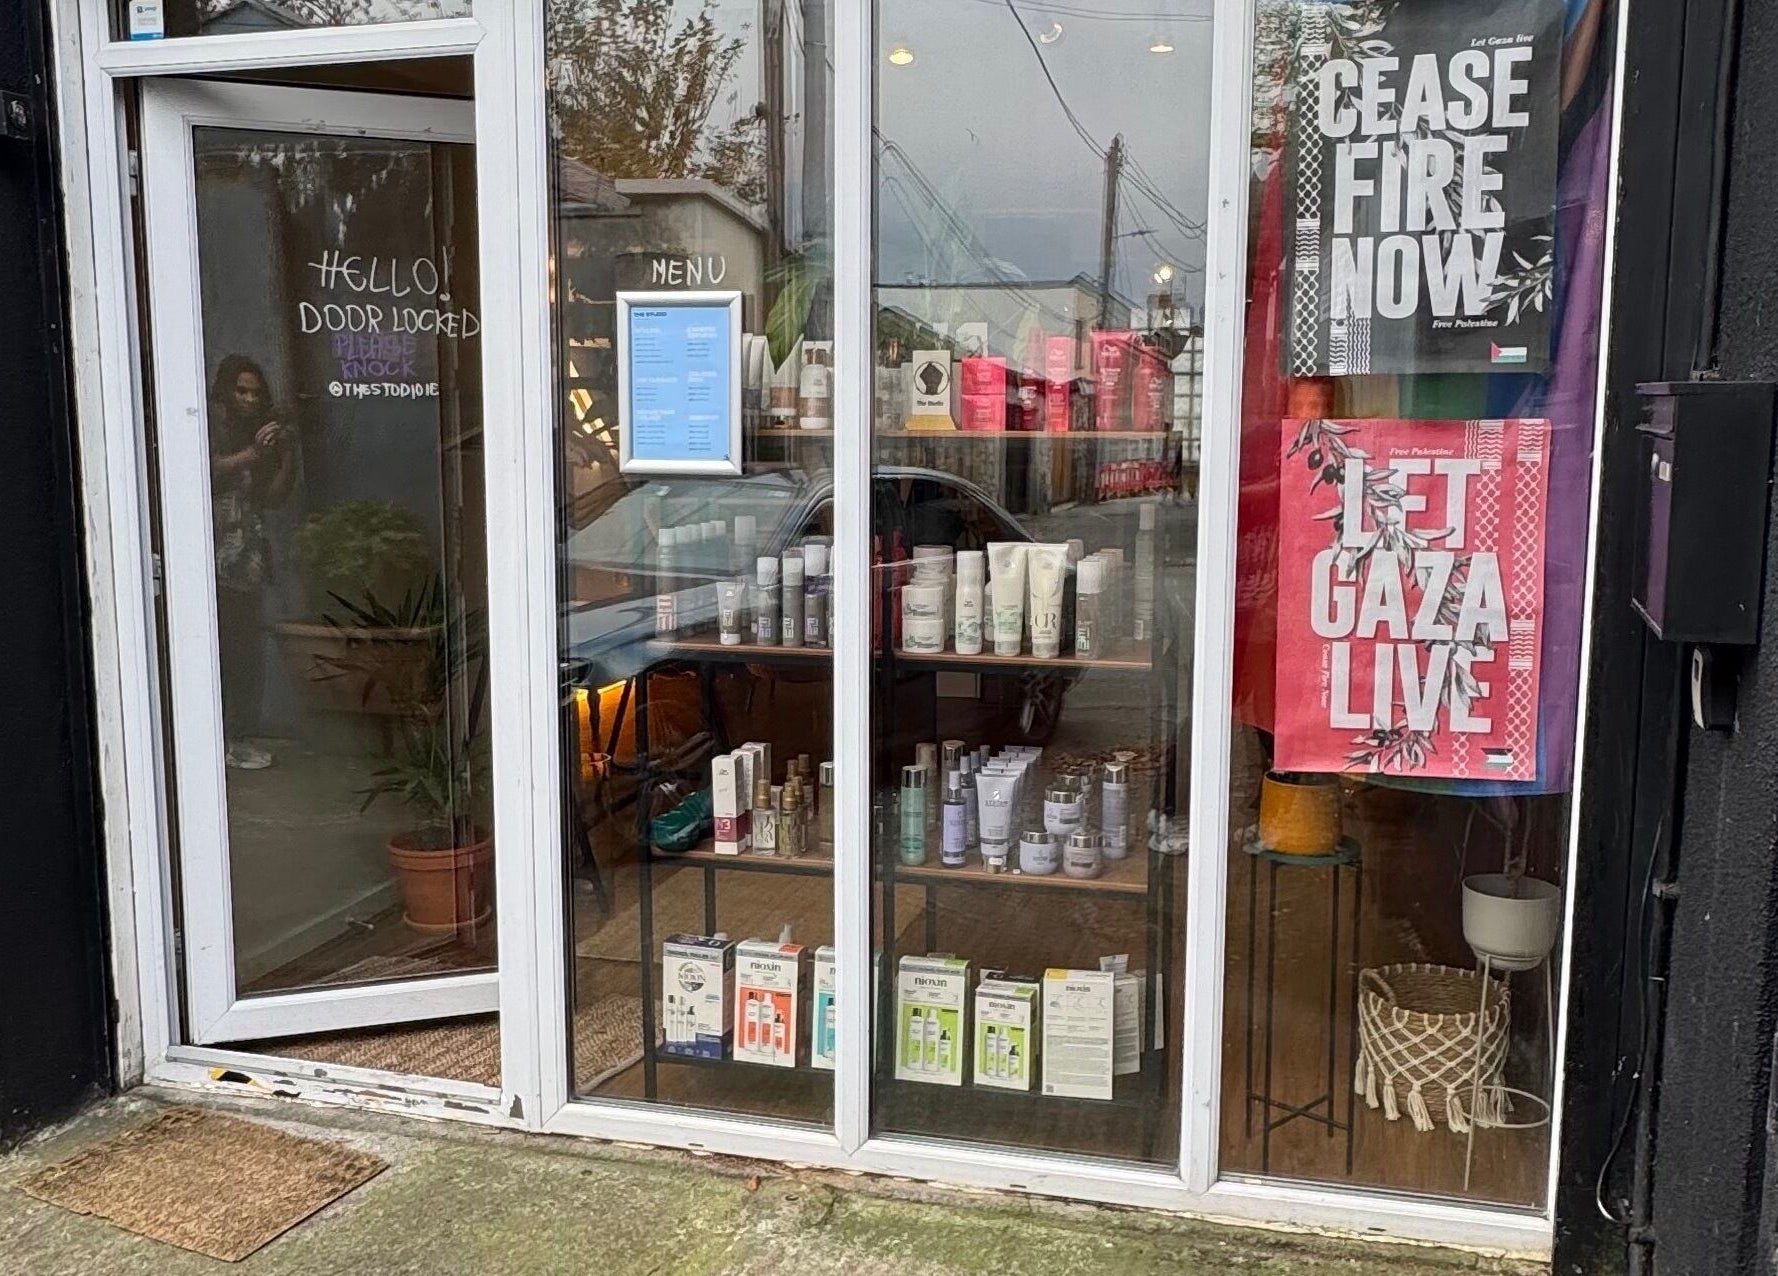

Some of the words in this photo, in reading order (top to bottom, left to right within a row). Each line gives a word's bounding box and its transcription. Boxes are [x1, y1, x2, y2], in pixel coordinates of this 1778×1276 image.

[1318, 46, 1533, 138] CEASE
[1333, 135, 1508, 234] FIRE
[308, 246, 452, 301] HELLO!
[652, 256, 726, 286] MENU
[1330, 231, 1506, 320] NOW
[299, 302, 384, 334] DOOR
[392, 307, 481, 340] LOCKED
[341, 359, 416, 379] KNOCK
[1343, 458, 1481, 549] LET
[1310, 549, 1509, 643] GAZA
[1329, 641, 1496, 734] LIVE
